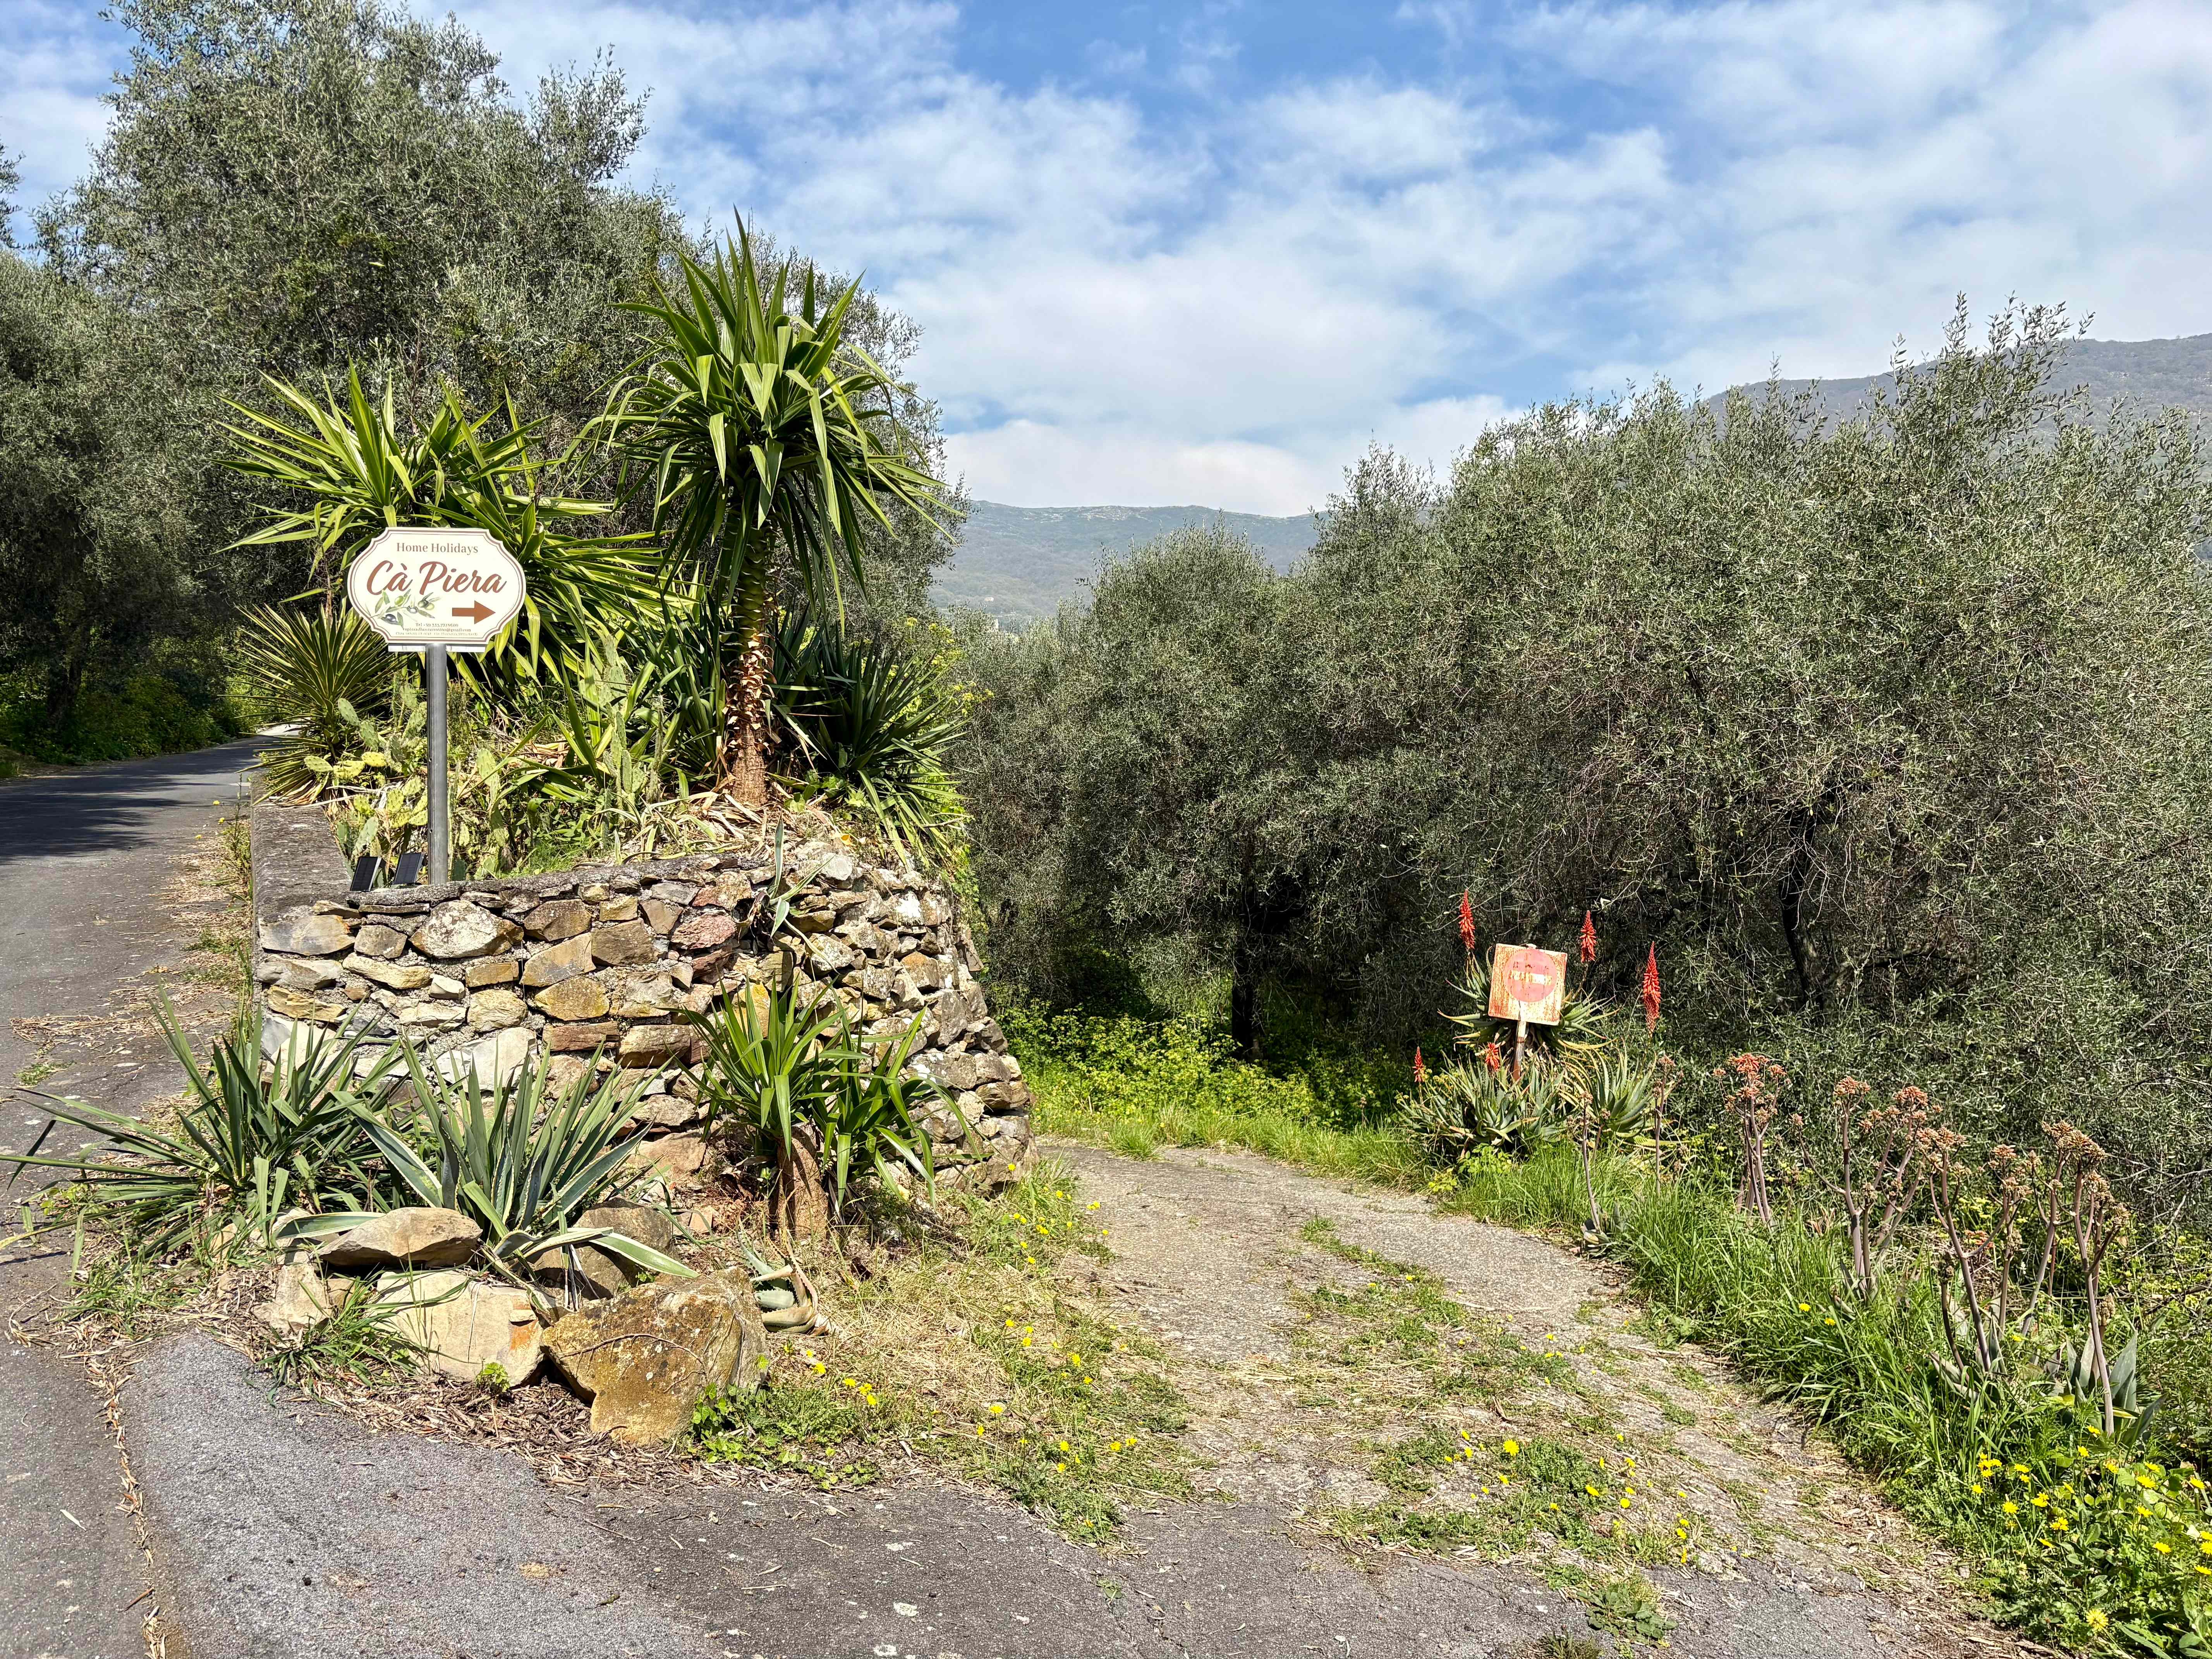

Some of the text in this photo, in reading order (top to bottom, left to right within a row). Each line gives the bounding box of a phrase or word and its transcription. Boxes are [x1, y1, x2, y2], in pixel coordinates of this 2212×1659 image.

[397, 543, 478, 555] Home Holidays
[367, 560, 507, 595] Cà Piera
